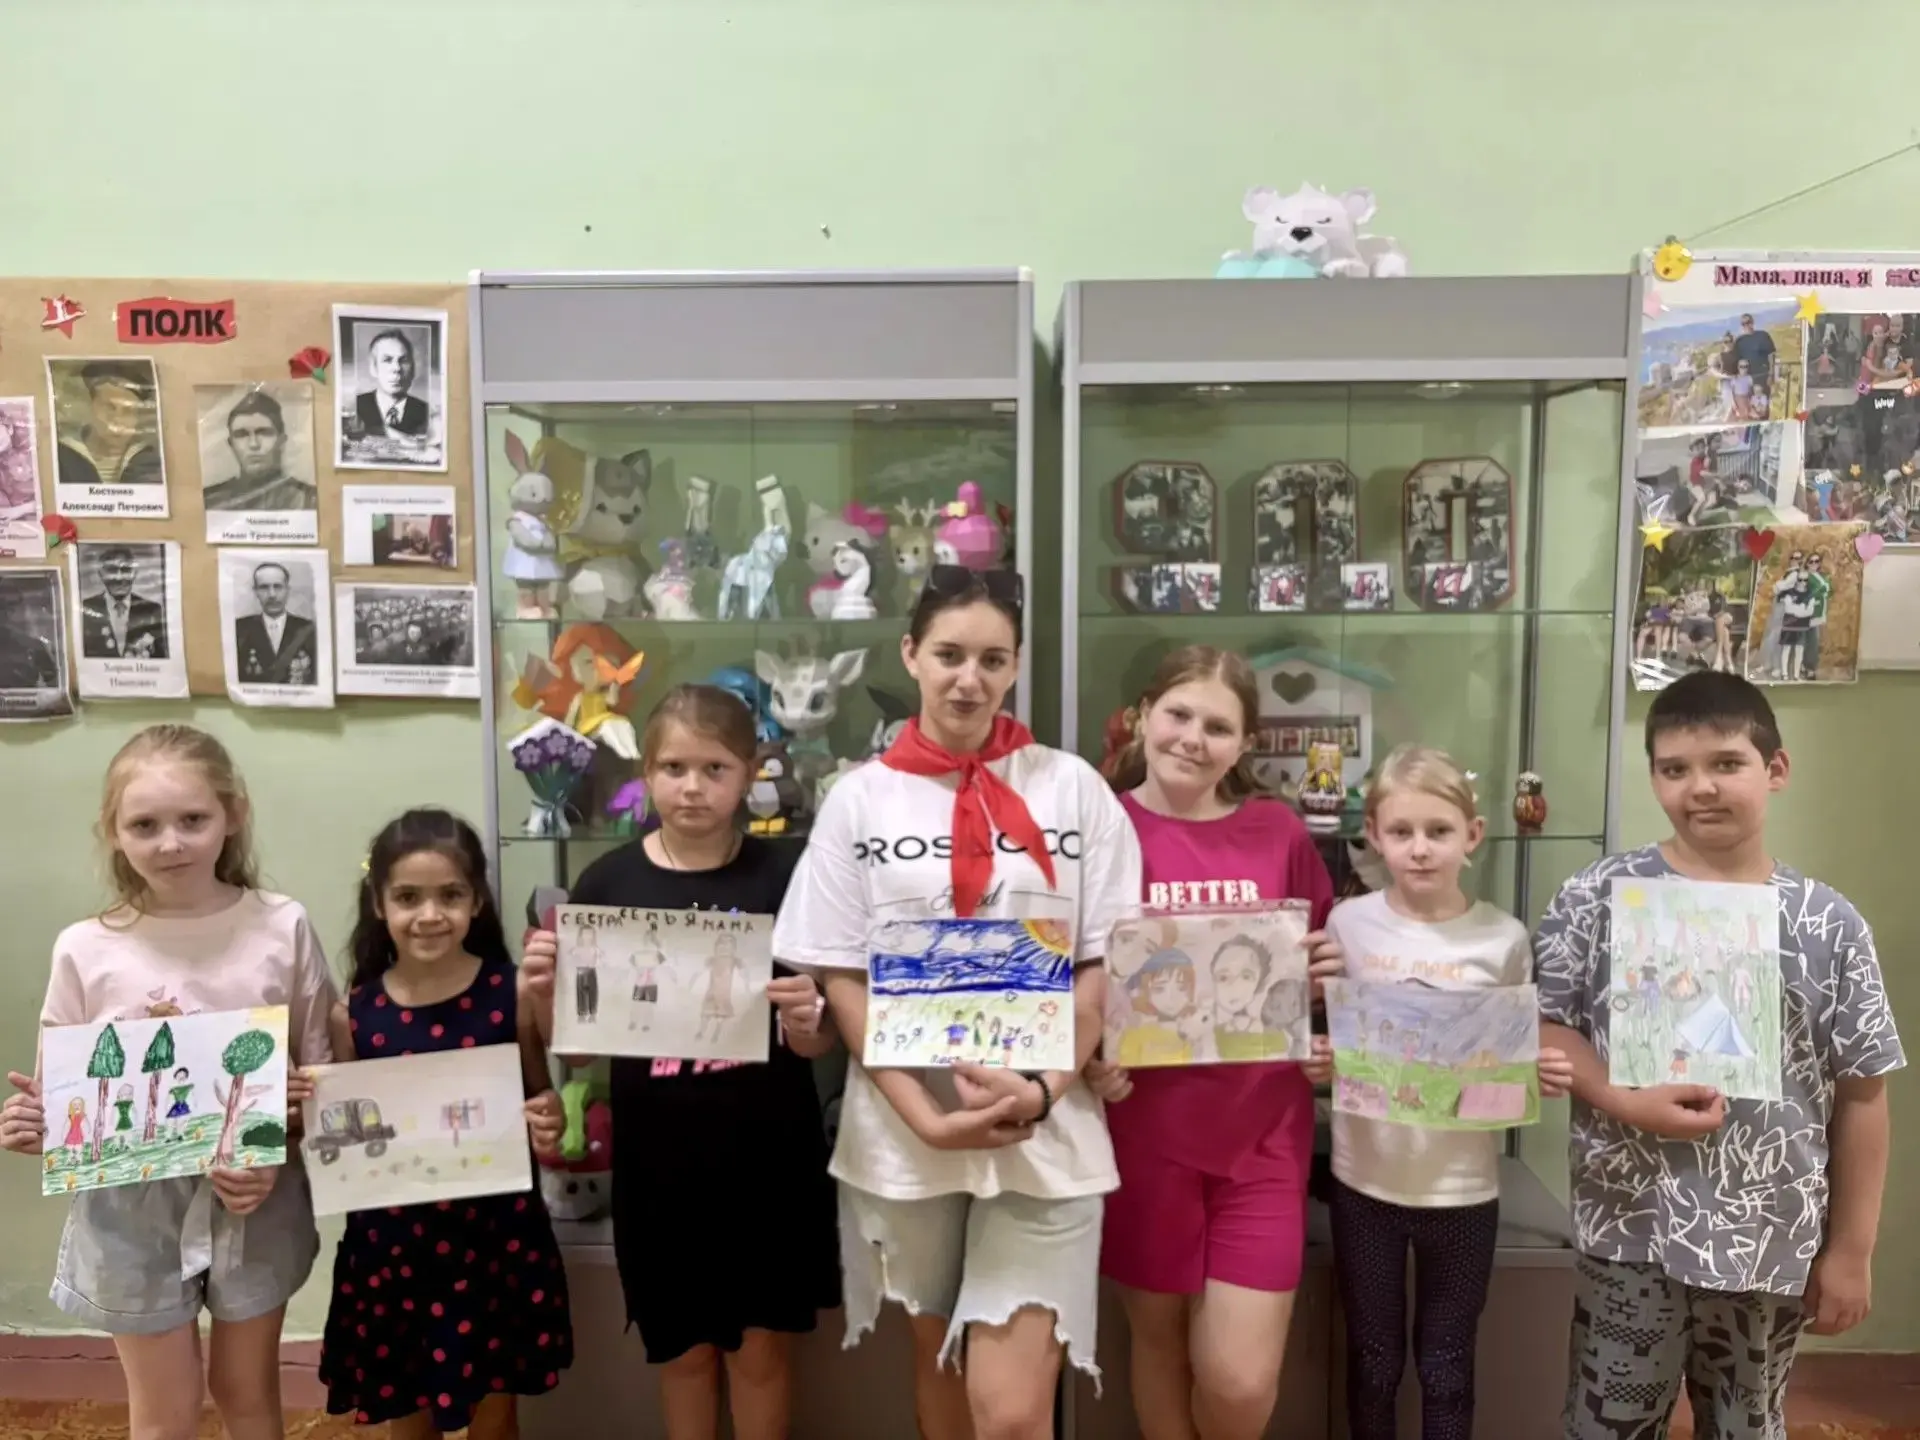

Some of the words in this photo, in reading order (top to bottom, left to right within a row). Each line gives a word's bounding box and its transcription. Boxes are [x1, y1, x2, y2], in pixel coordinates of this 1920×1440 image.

[1716, 264, 1786, 286] Мама,
[1792, 268, 1850, 286] папа,
[1857, 268, 1869, 285] я
[129, 308, 226, 337] ПОЛК
[62, 502, 115, 512] Александр
[117, 502, 164, 512] Петрович
[1149, 879, 1260, 910] BETTER
